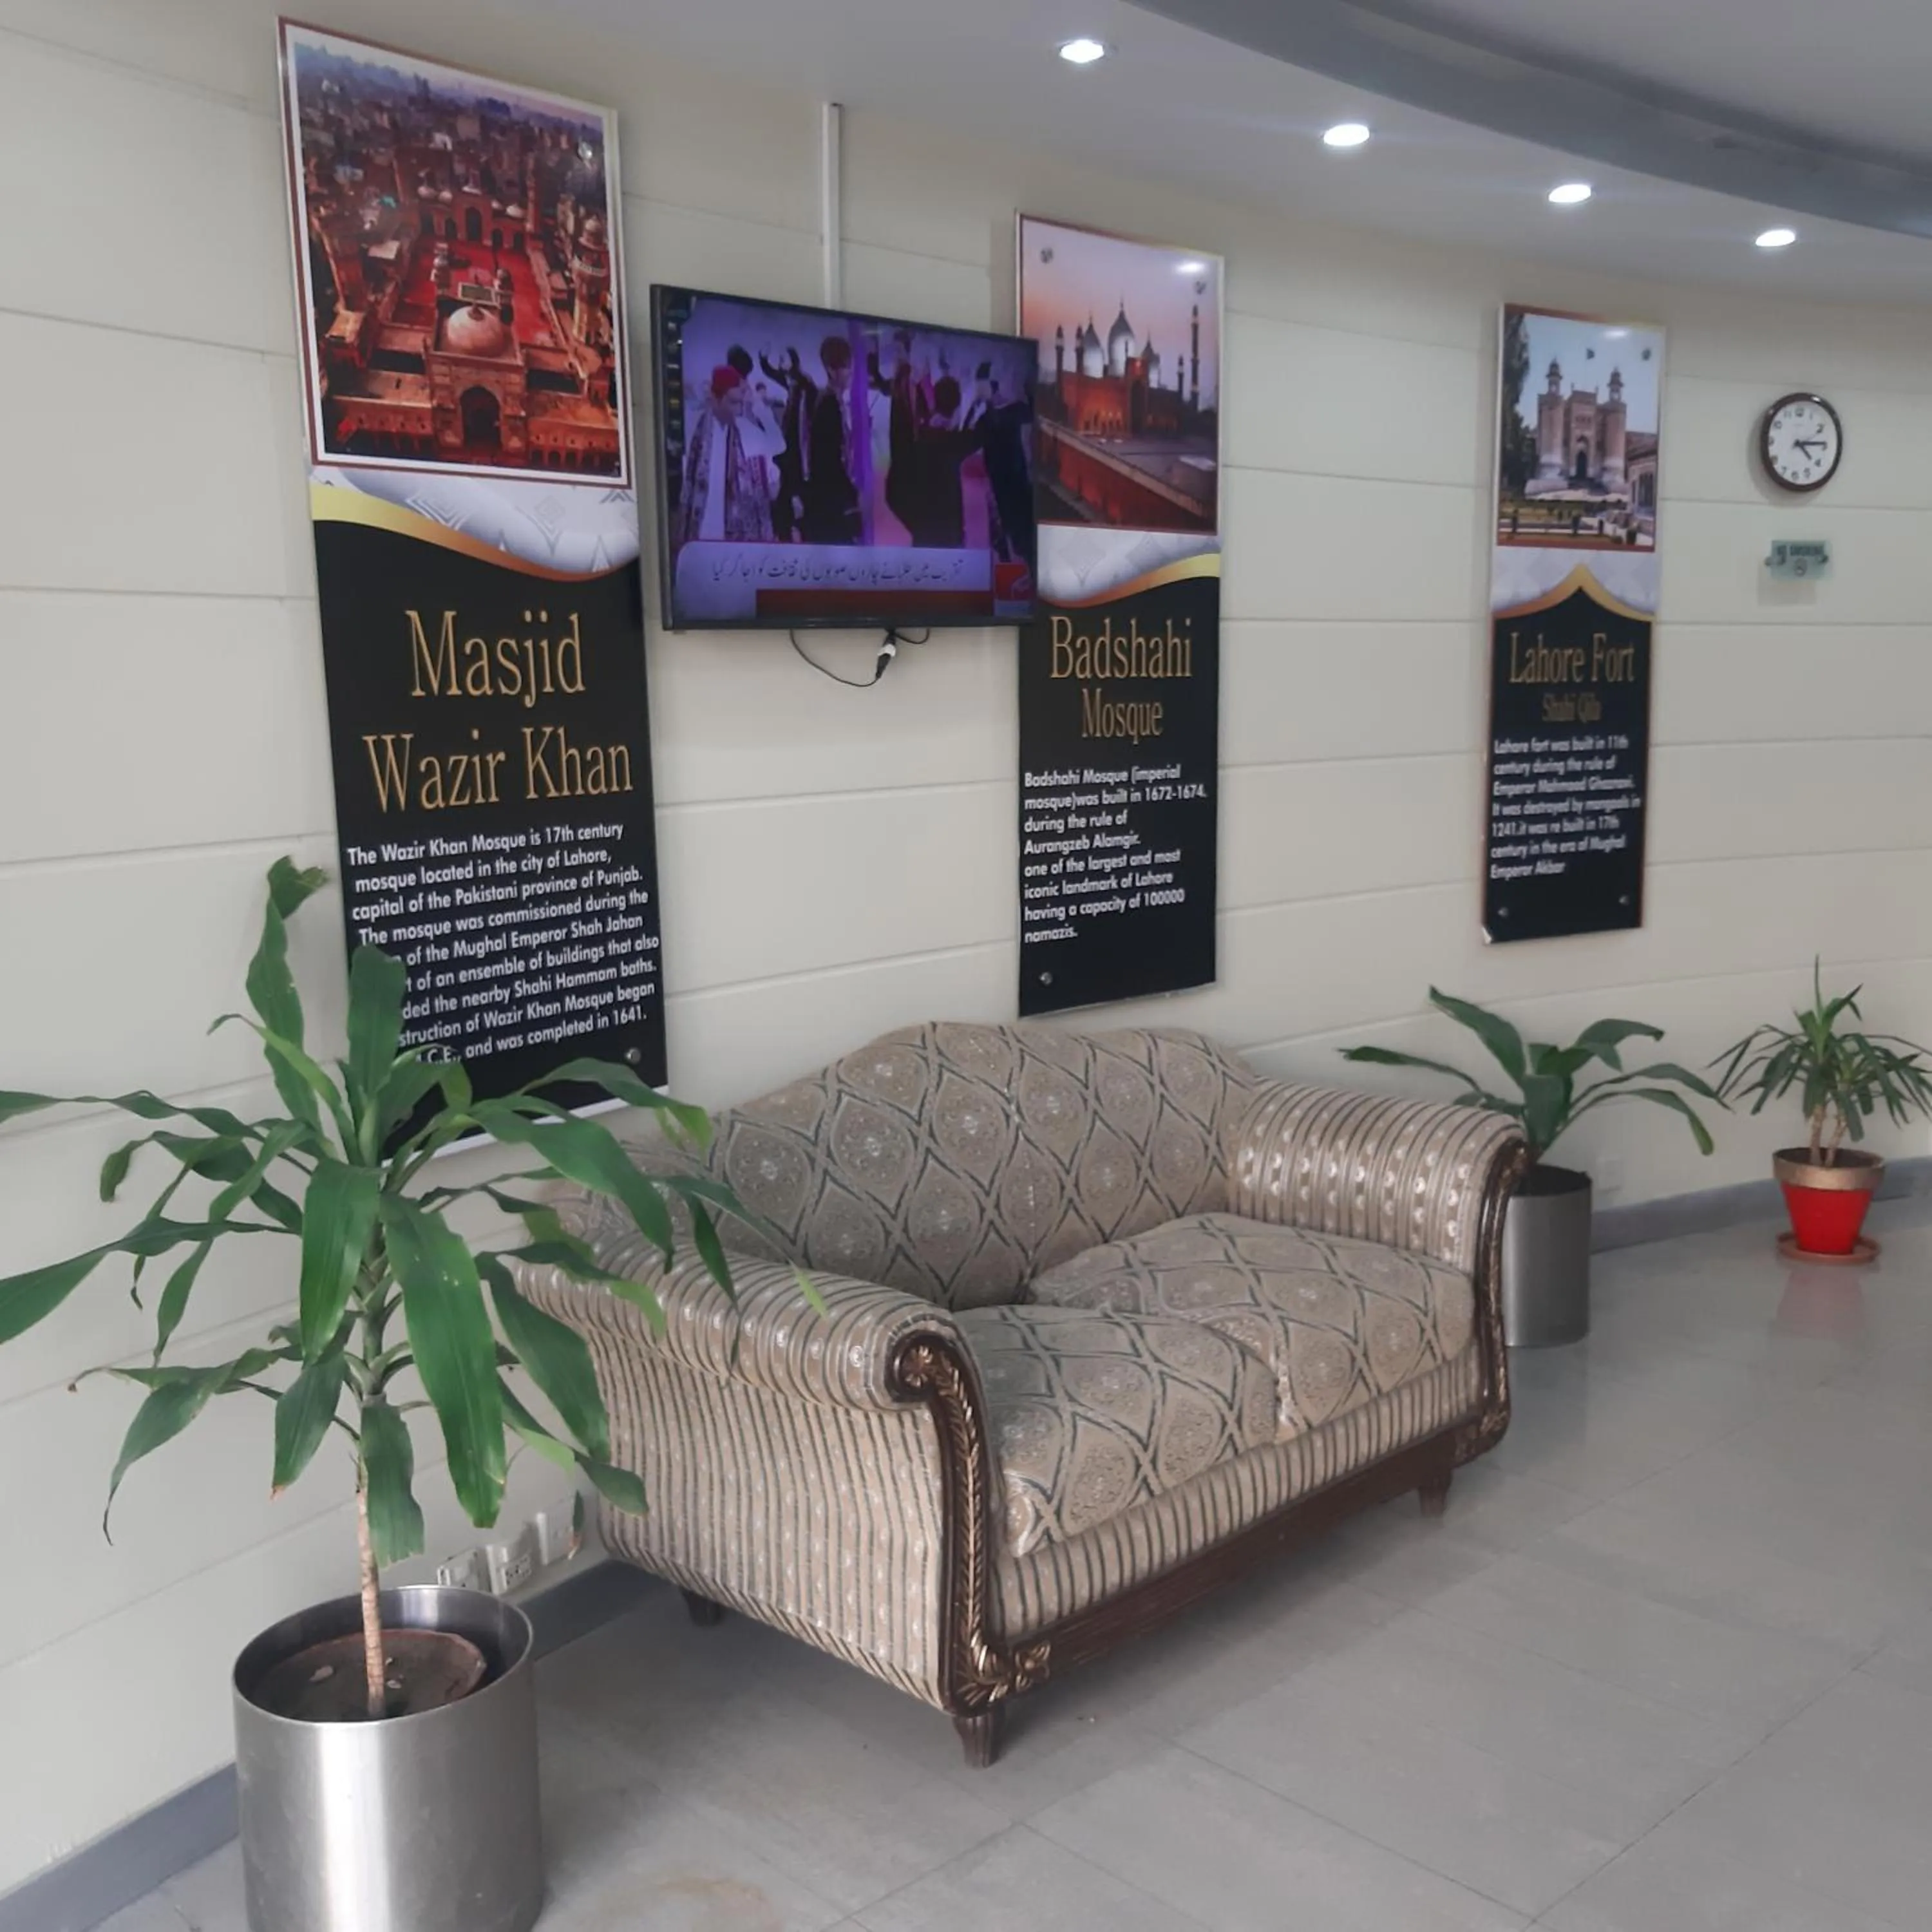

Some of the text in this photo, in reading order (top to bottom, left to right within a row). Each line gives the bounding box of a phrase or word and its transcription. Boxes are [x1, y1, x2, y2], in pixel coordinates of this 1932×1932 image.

[405, 609, 585, 708] Masjid
[1050, 616, 1191, 679] Badshahi
[1509, 632, 1634, 683] Lahore Fort
[1082, 688, 1163, 745] Mosque
[1495, 738, 1529, 754] Lahore
[1596, 735, 1605, 750] in
[362, 726, 634, 813] Wazir Khan
[1025, 769, 1080, 788] Badshahi
[1083, 769, 1128, 785] Mosque
[1493, 781, 1536, 798] Emperor
[1494, 761, 1531, 777] century
[1102, 789, 1127, 804] built
[1131, 789, 1141, 802] in
[347, 823, 623, 866] The Wazir Khan Mosque is 17th century
[1025, 809, 1128, 833] during the rule of
[1025, 835, 1090, 855] Aurangzeb
[355, 848, 611, 893] mosque located in the city of Lahore,
[1025, 849, 1180, 877] one of the largest and most
[1025, 871, 1173, 899] iconic landmark of Lahore
[352, 866, 643, 923] capital of the Pakistani province of Punjab.
[359, 889, 648, 946] The mosque was commissioned during the
[1025, 904, 1066, 921] having
[1068, 905, 1076, 916] a
[1079, 896, 1126, 916] capacity
[1129, 893, 1140, 908] of
[406, 914, 643, 965] of the Mughal Emperor Shah Jahan
[417, 971, 431, 990] of
[436, 972, 454, 987] an
[459, 956, 526, 983] ensemble
[529, 951, 542, 969] of
[546, 945, 605, 967] buildings
[608, 938, 631, 955] that
[635, 934, 659, 951] also
[435, 994, 457, 1014] the
[462, 984, 511, 1008] nearby
[515, 974, 552, 998] Shahi
[556, 968, 617, 989] Hammam
[621, 958, 656, 976] baths.
[399, 983, 655, 1046] struction of Wazir Khan Mosque began
[466, 1036, 492, 1058] and
[497, 1035, 523, 1051] was
[527, 1015, 593, 1045] completed
[598, 1013, 609, 1028] in
[614, 1005, 647, 1025] 1641.
